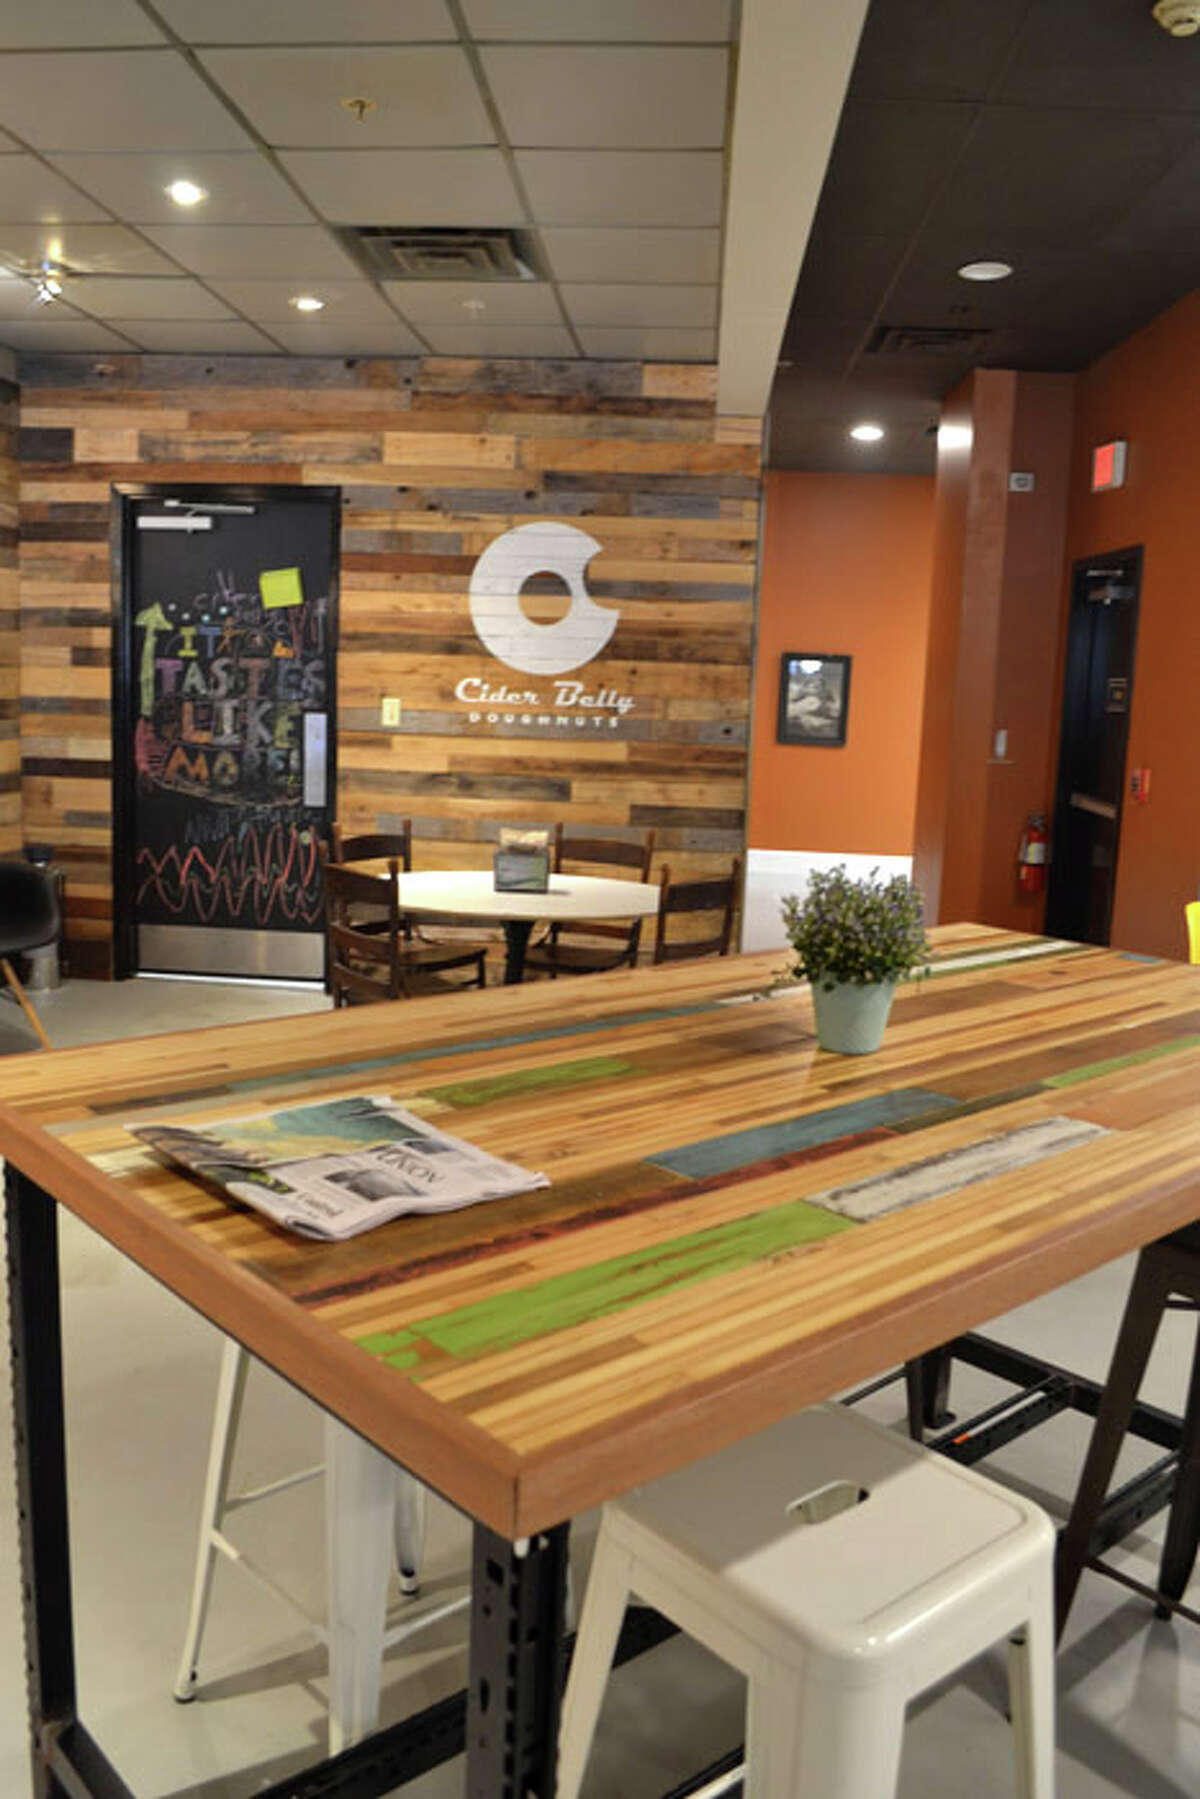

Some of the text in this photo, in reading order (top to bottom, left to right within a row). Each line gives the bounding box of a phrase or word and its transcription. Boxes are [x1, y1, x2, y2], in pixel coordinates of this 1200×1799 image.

[155, 658, 327, 700] TASTES
[455, 677, 635, 714] Cider Belly
[181, 699, 304, 748] LIKE
[469, 712, 618, 728] DOUGHNUTS
